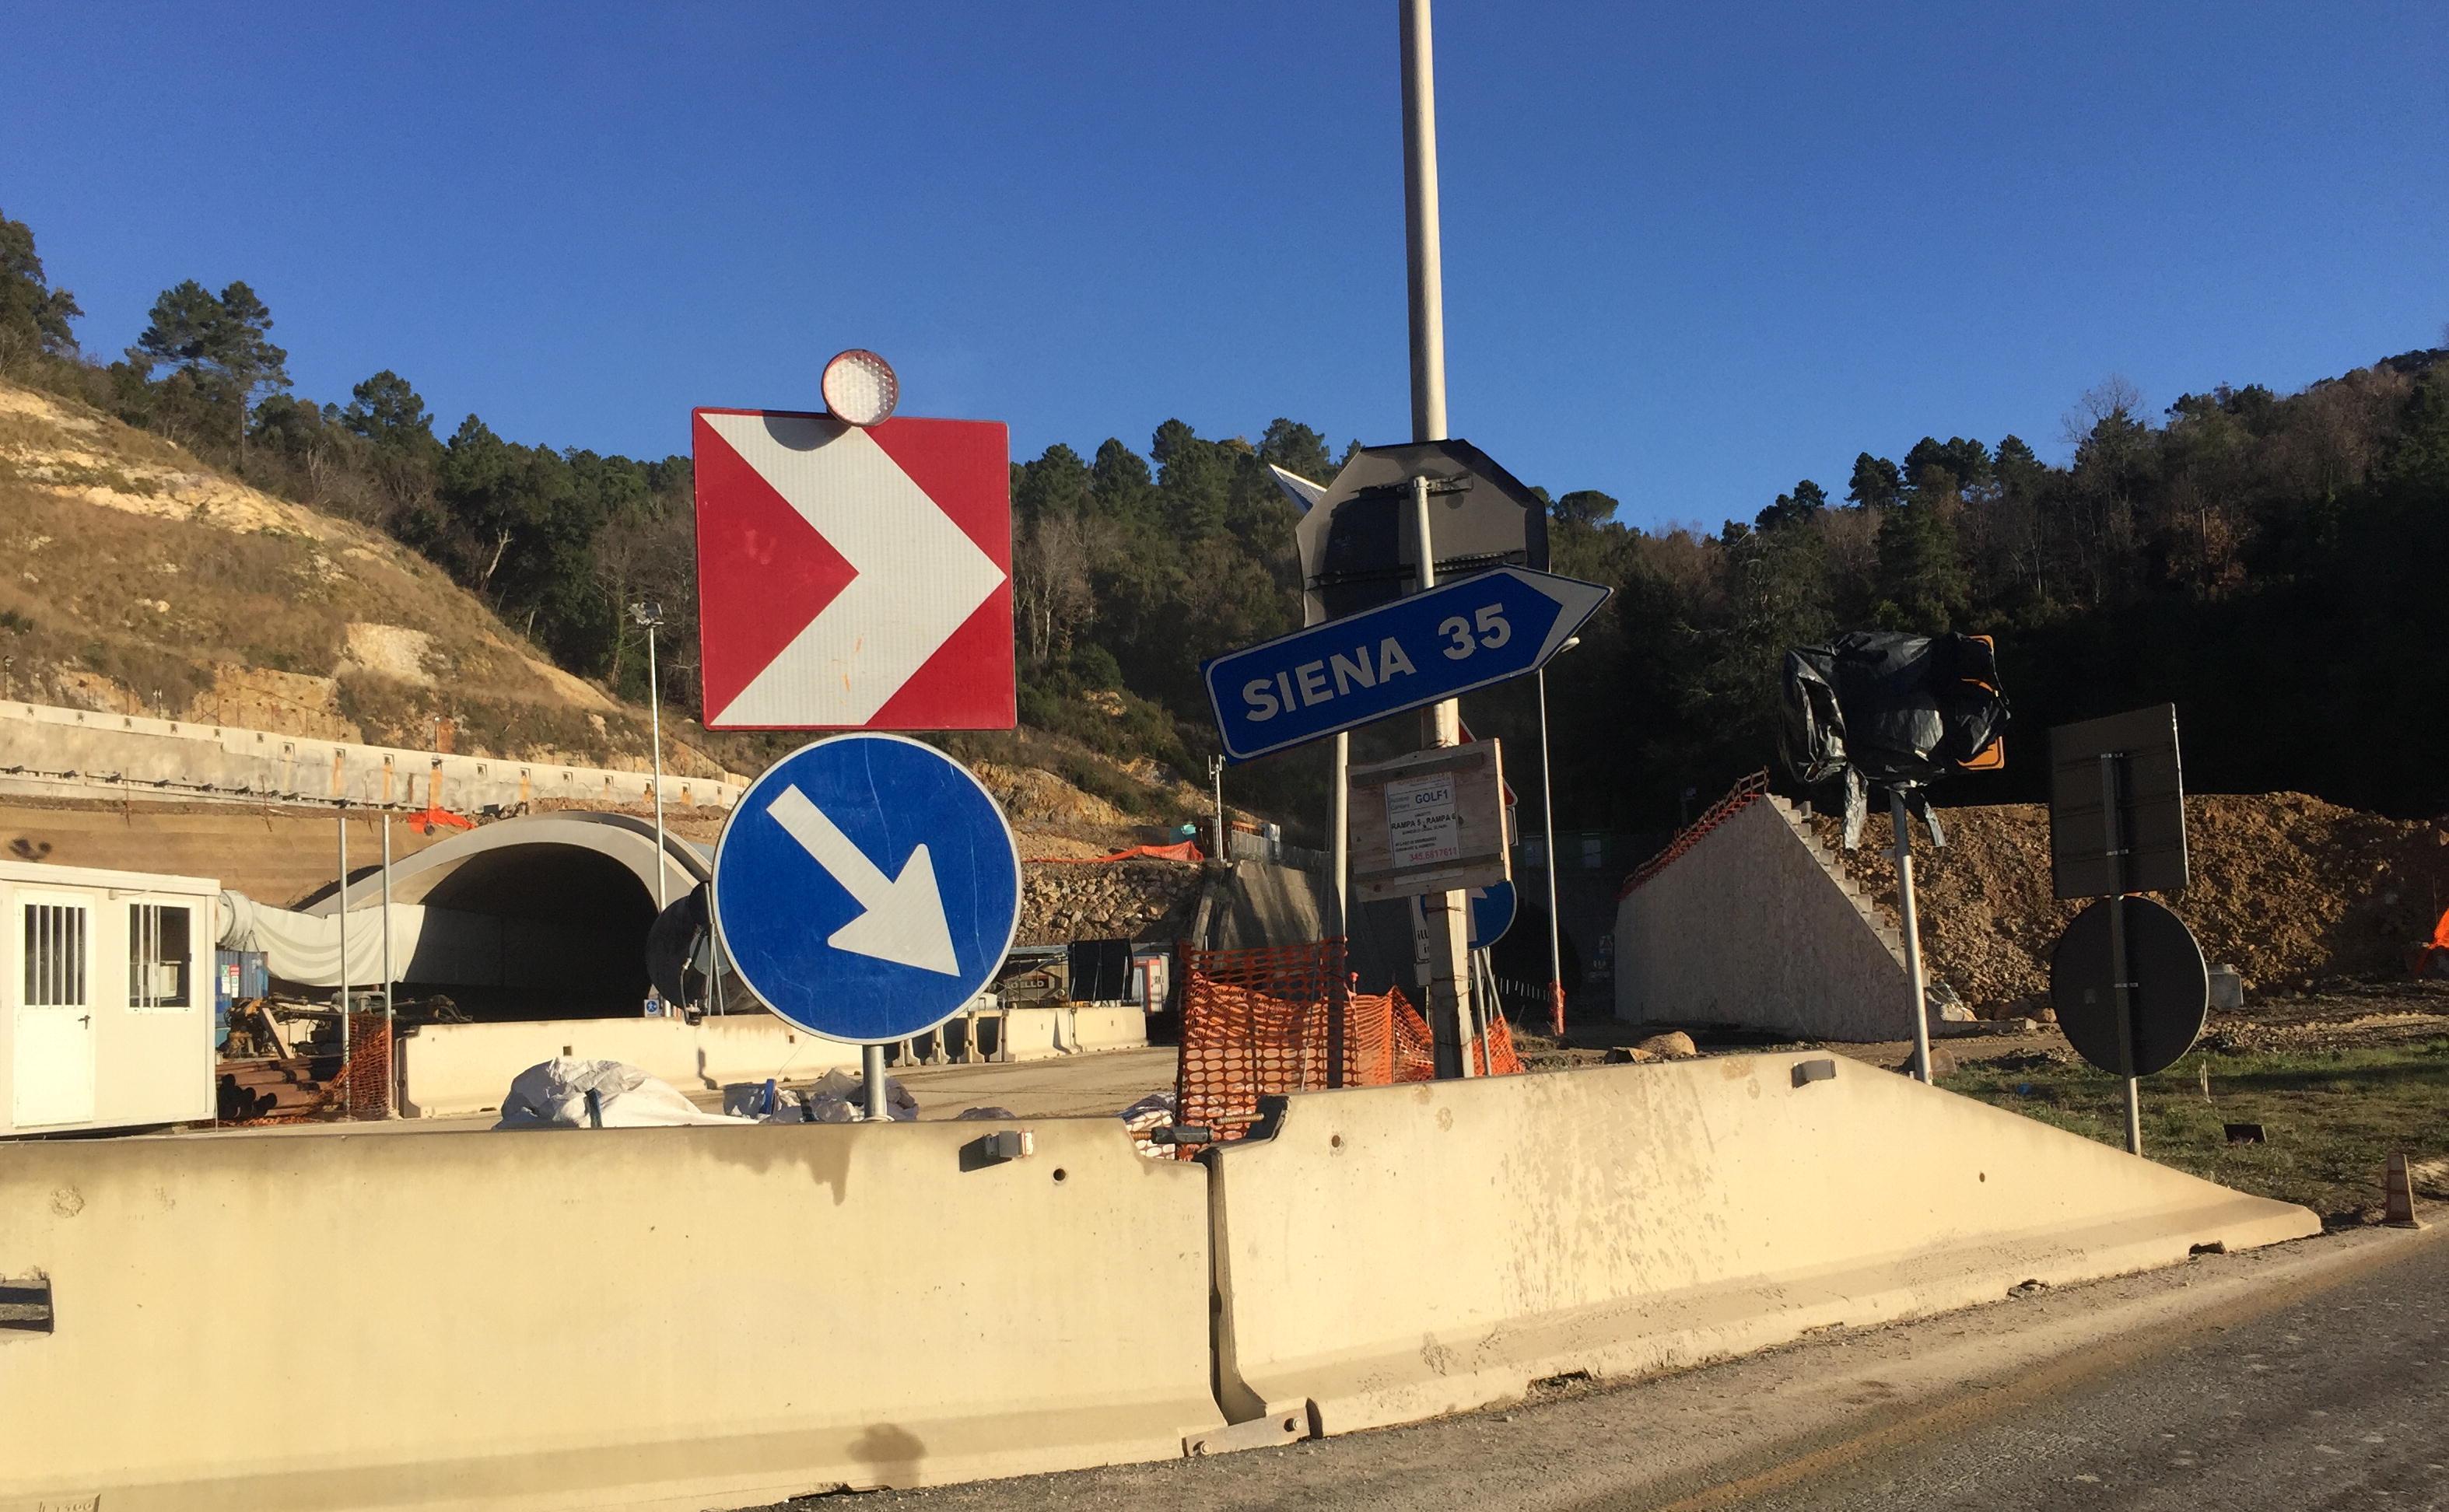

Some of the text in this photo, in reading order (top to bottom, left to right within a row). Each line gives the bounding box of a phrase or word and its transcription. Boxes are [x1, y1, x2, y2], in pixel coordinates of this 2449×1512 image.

[1242, 603, 1512, 722] SIENA 35
[1415, 789, 1448, 803] GOLF1
[1391, 820, 1415, 829] RAMPA
[1426, 814, 1451, 824] RAMPA
